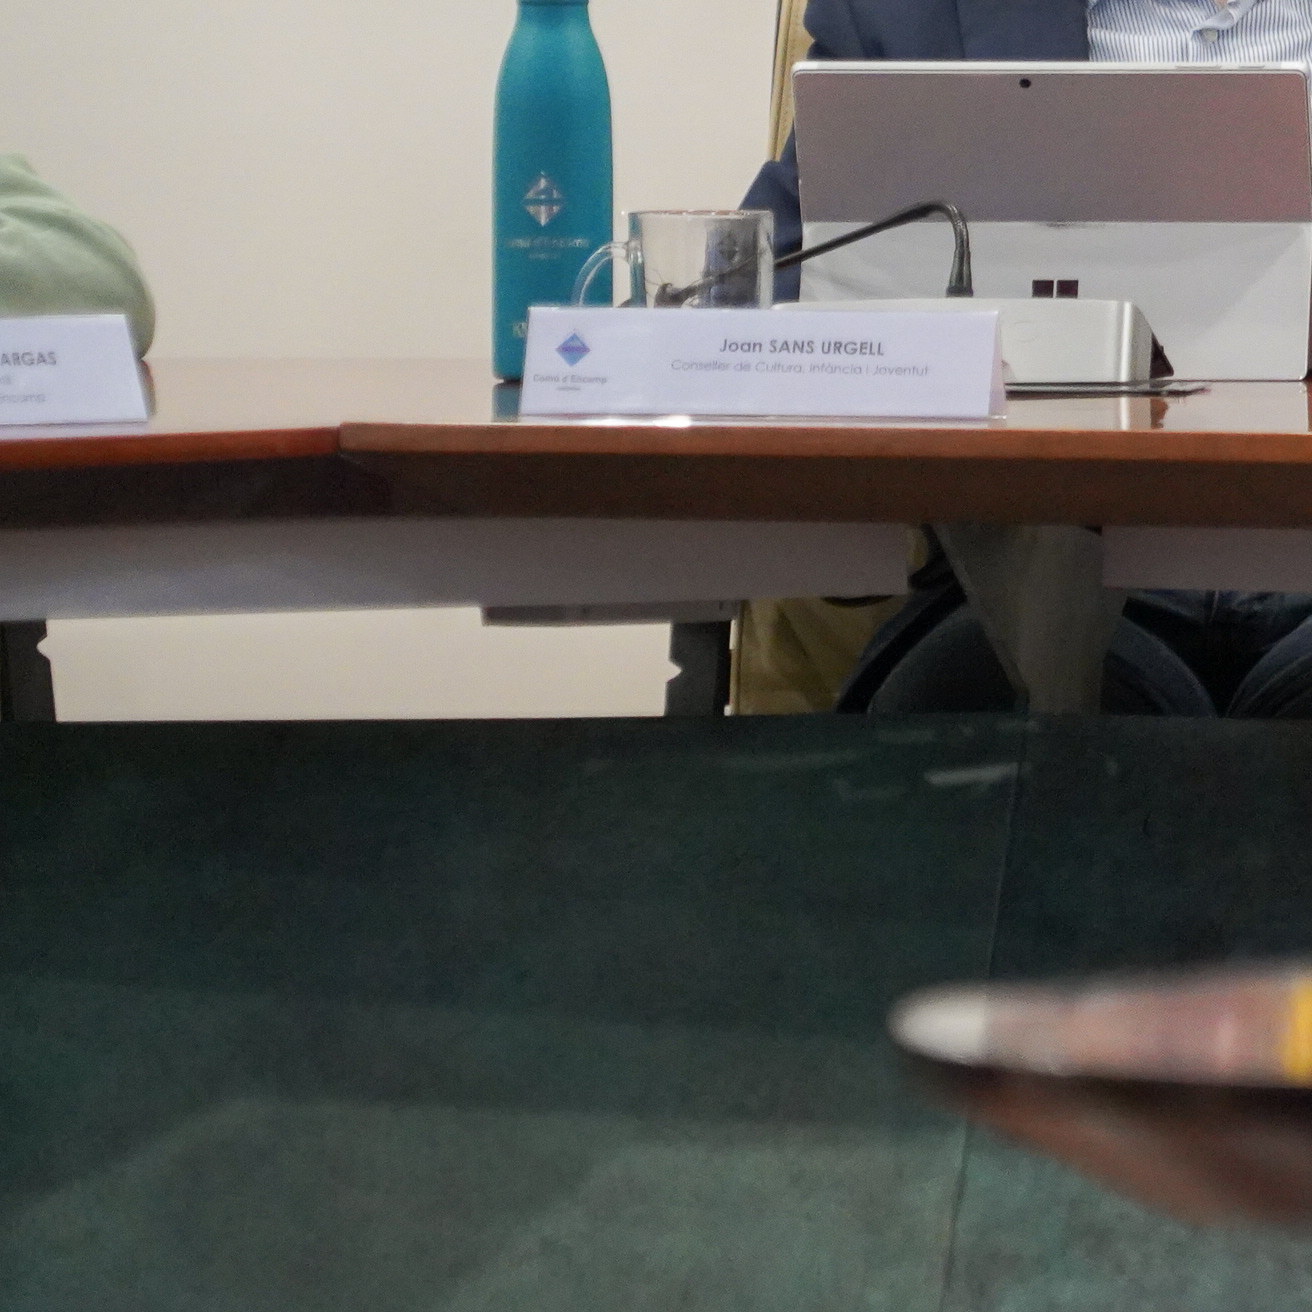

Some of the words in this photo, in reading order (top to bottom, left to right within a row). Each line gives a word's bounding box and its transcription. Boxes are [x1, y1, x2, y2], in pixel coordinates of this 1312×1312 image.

[719, 338, 763, 353] Joan
[768, 339, 815, 355] SANS
[821, 340, 885, 357] URGELL
[0, 351, 57, 367] ARGAS
[733, 361, 751, 373] de
